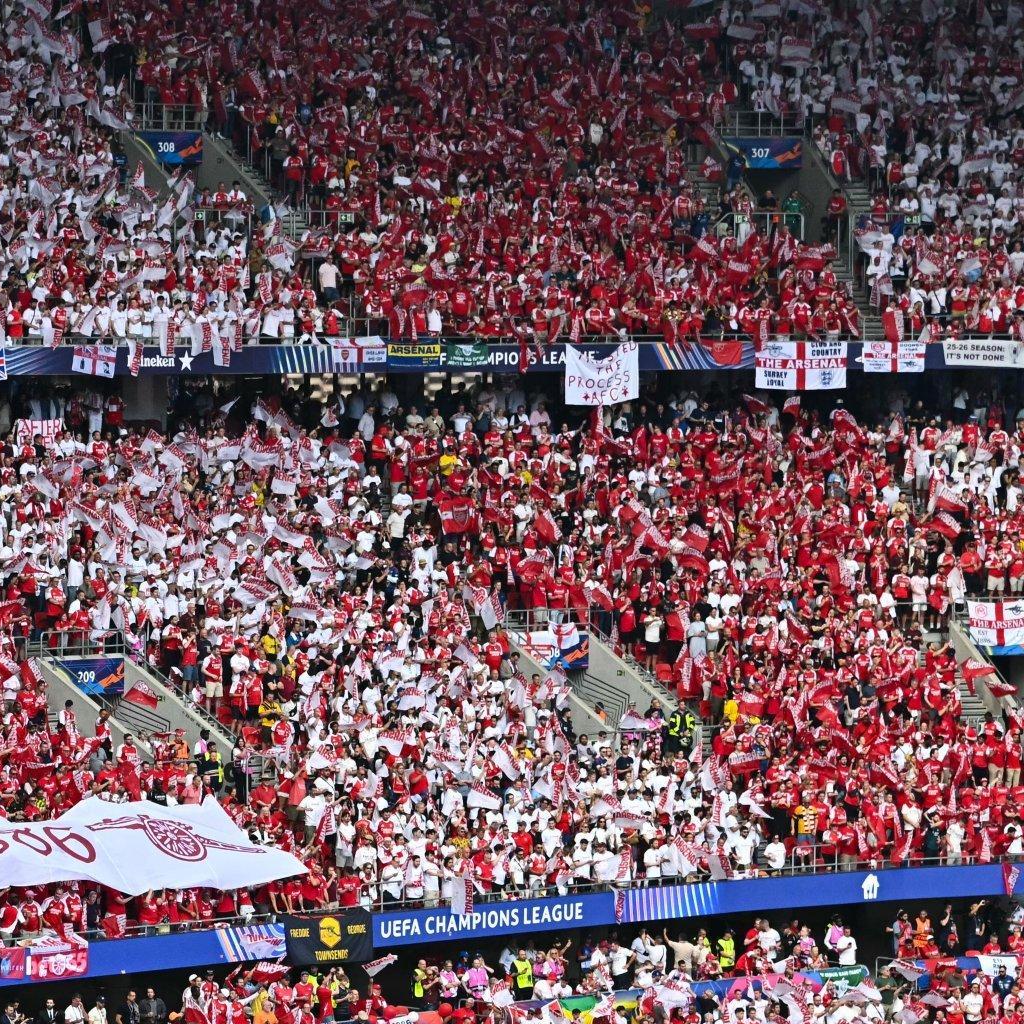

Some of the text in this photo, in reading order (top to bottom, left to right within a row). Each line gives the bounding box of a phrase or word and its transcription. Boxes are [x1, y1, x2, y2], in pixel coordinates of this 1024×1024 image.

[157, 142, 175, 152] 308
[751, 148, 770, 158] 307
[389, 344, 439, 356] ARSENAL
[811, 348, 842, 357] COUNTRY
[970, 344, 1005, 352] SEASON:
[127, 355, 175, 368] ineken
[758, 358, 844, 369] THE ARSENAL
[982, 354, 1005, 362] DONE
[596, 360, 622, 375] THE
[569, 371, 630, 388] PROCESS
[764, 370, 788, 379] SURREY
[590, 387, 618, 404] AFC
[77, 671, 95, 684] 209
[380, 902, 584, 939] UEFA CHAMPIONS LEAGUE
[314, 949, 349, 961] TOWNSENDS
